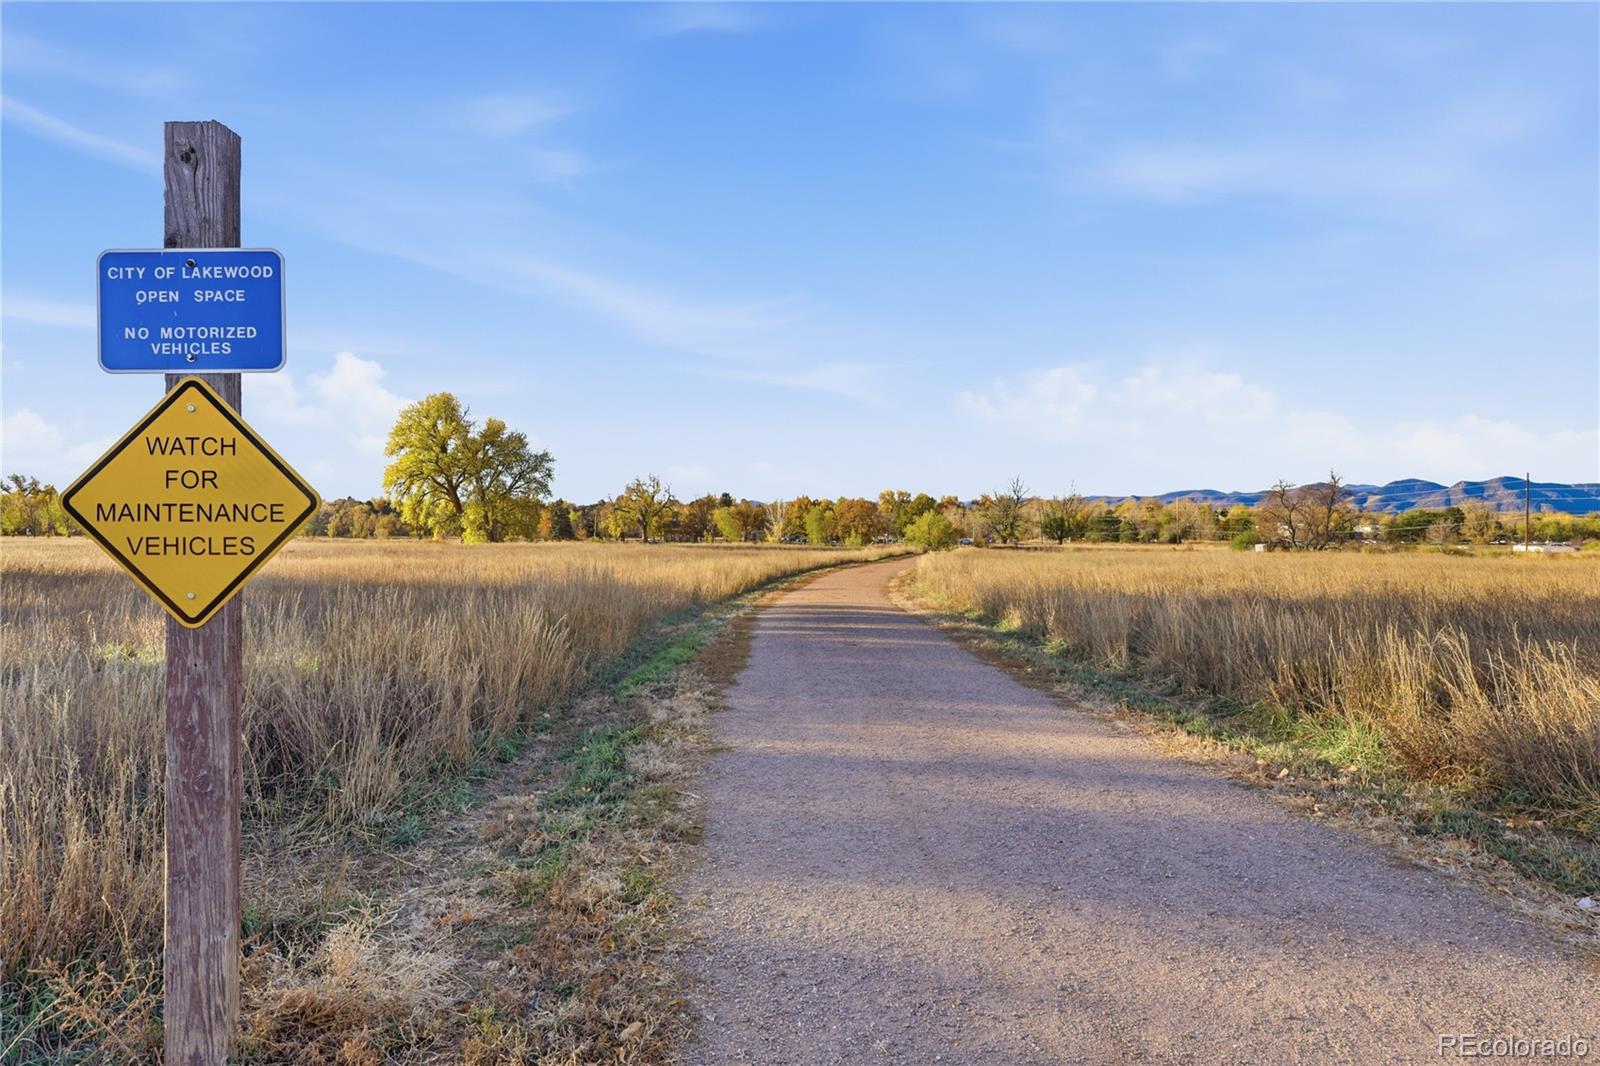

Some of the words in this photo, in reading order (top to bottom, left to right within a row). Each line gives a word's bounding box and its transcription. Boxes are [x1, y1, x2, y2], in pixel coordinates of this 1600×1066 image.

[107, 266, 145, 280] CITY
[154, 266, 175, 279] OF
[182, 265, 273, 279] LAKEWOOD
[136, 290, 179, 303] OPEN
[193, 289, 245, 302] SPACE
[124, 327, 149, 340] NO
[160, 326, 257, 339] MOTORIZED
[151, 342, 232, 355] VEHICLES
[146, 436, 236, 456] WATCH
[165, 469, 218, 489] FOR
[96, 503, 285, 523] MAINTENANCE
[126, 536, 255, 556] VEHICLES
